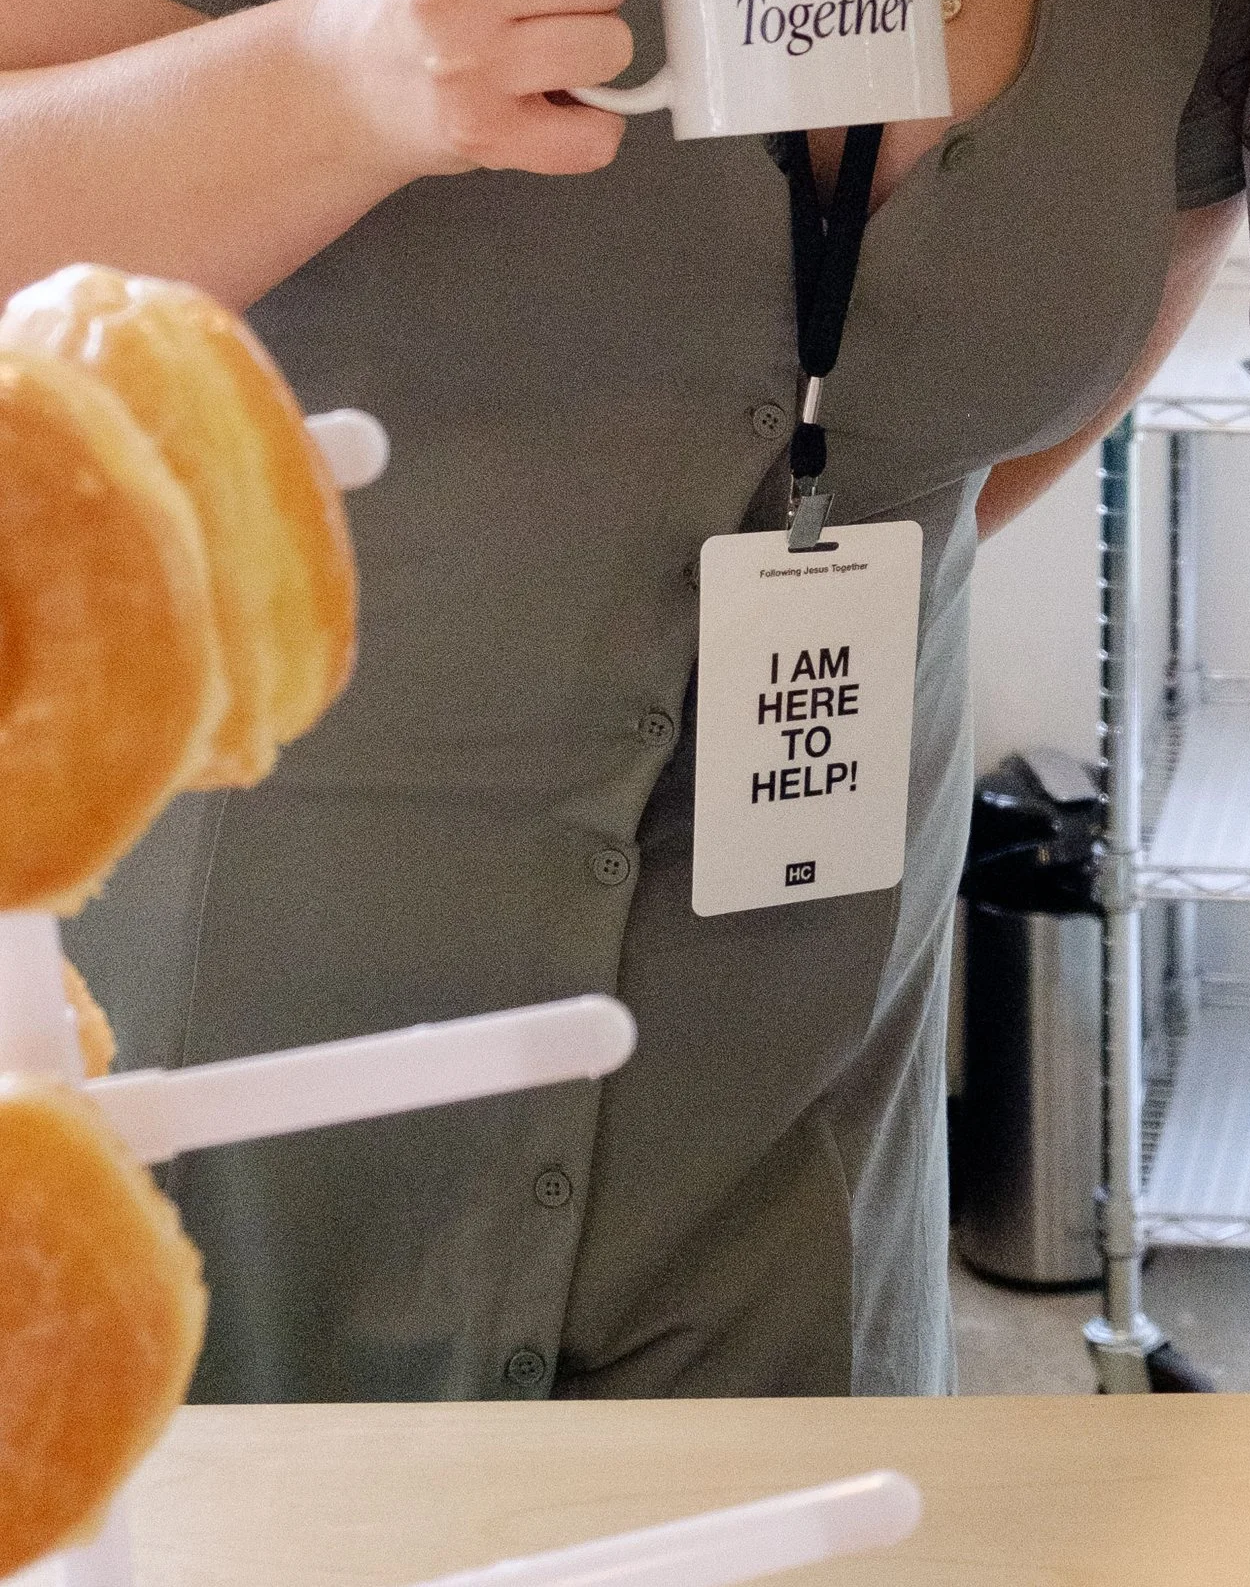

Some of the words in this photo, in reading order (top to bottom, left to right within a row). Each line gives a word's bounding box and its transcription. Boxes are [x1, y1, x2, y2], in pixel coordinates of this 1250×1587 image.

[760, 568, 802, 578] Following
[803, 566, 829, 575] Jesus
[831, 562, 868, 573] Together
[771, 653, 779, 684] I
[790, 646, 850, 683] AM
[758, 684, 859, 724] HERE
[781, 726, 831, 761] TO
[752, 761, 857, 804] HELP!
[787, 864, 813, 882] HC
